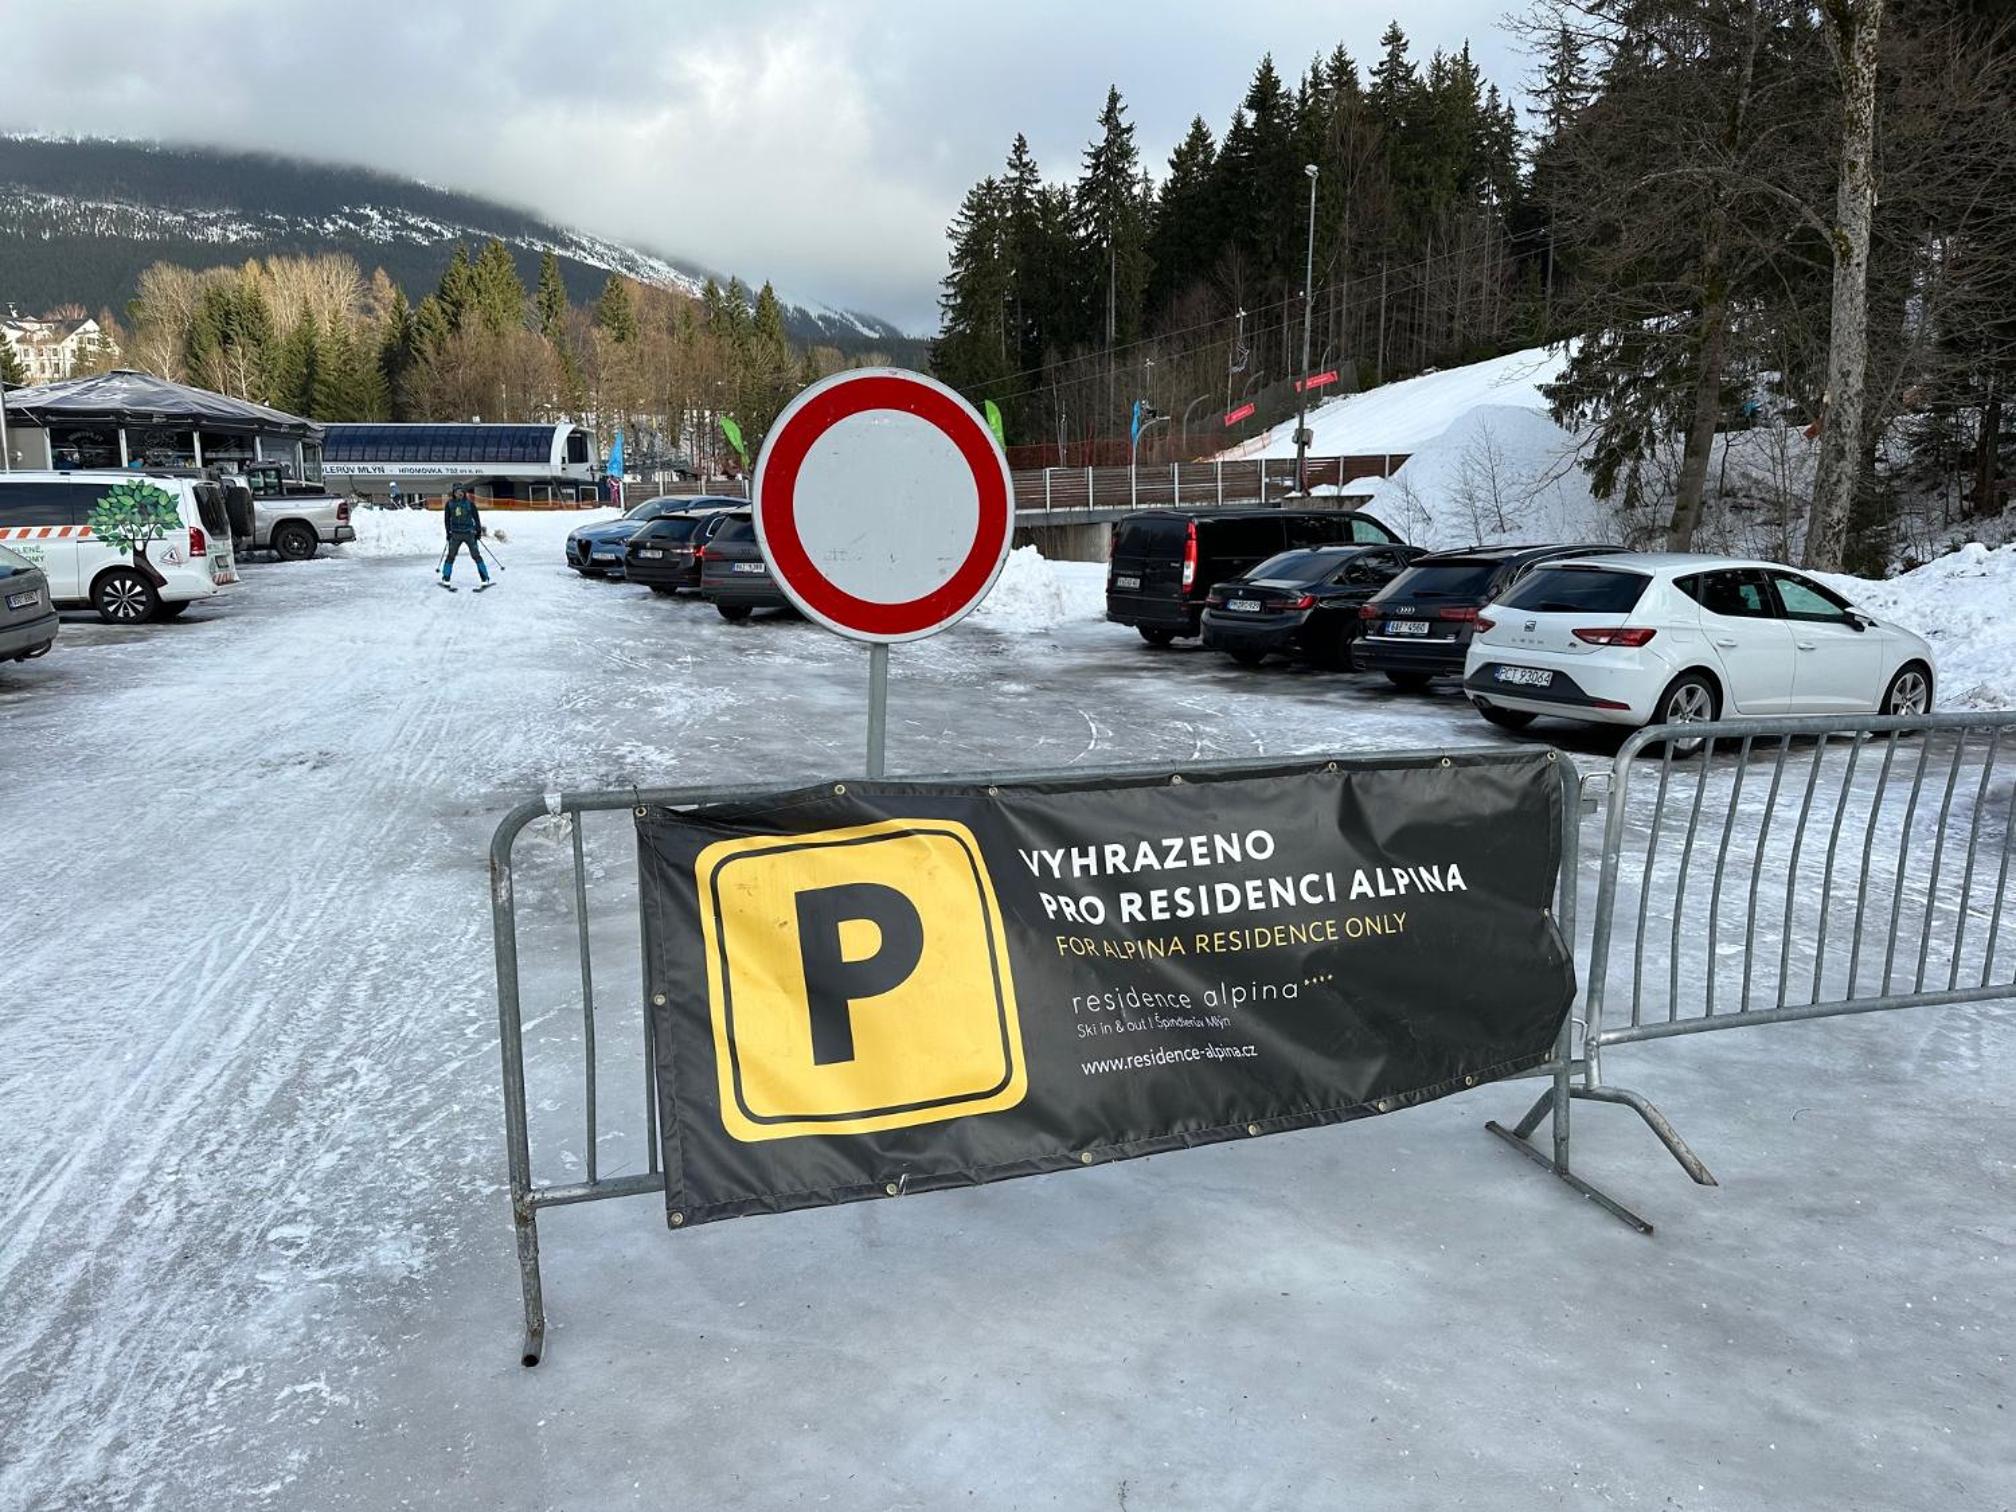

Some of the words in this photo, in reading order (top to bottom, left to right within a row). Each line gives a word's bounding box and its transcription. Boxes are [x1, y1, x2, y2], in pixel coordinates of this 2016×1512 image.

[1500, 667, 1518, 680] PCT
[1519, 670, 1551, 685] 93064
[1018, 829, 1275, 879] VYHRAZENO
[1039, 891, 1106, 926] PRO
[1119, 872, 1337, 924] RESIDENCI
[1349, 863, 1468, 900] ALPINA
[1056, 935, 1100, 957] FOR
[1103, 935, 1187, 960] ALPINA
[1195, 919, 1339, 954] RESIDENCE
[1345, 911, 1407, 938] ONLY
[795, 882, 924, 1066] P
[1072, 985, 1192, 1014] residence
[1203, 981, 1299, 1009] alpina
[1077, 1022, 1096, 1039] Ski
[1100, 1022, 1113, 1035] in
[1115, 1019, 1124, 1033] &
[1126, 1019, 1148, 1032] out
[1081, 1043, 1258, 1076] www.residence-alpina.cz
